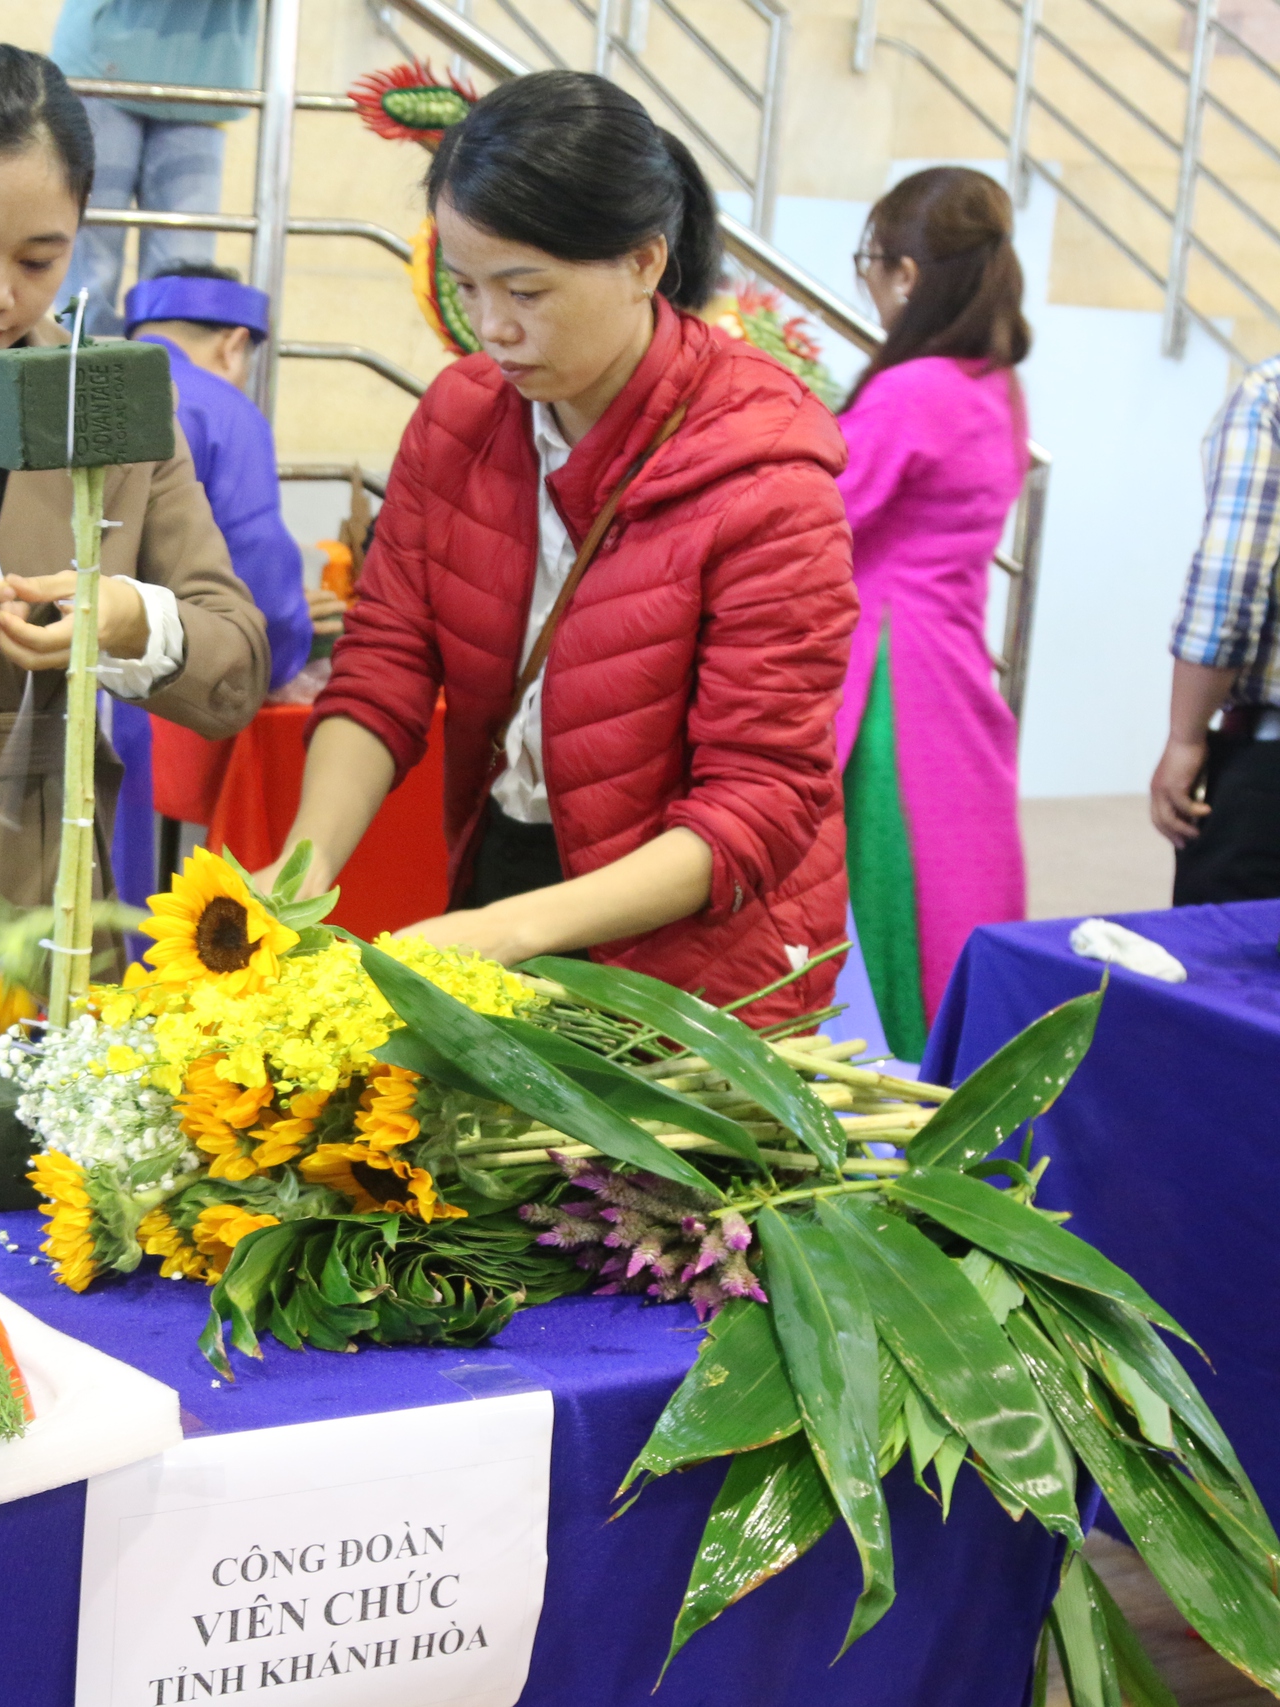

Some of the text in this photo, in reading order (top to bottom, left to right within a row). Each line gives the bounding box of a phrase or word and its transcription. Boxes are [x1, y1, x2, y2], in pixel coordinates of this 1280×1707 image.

[90, 364, 111, 456] ADVANTAGE
[114, 363, 124, 399] FOAM
[211, 1520, 447, 1587] CÔNG ĐOÀN
[191, 1569, 461, 1648] VIÊN CHỨC
[148, 1620, 490, 1707] TỈNH KHÁNH HÒA
